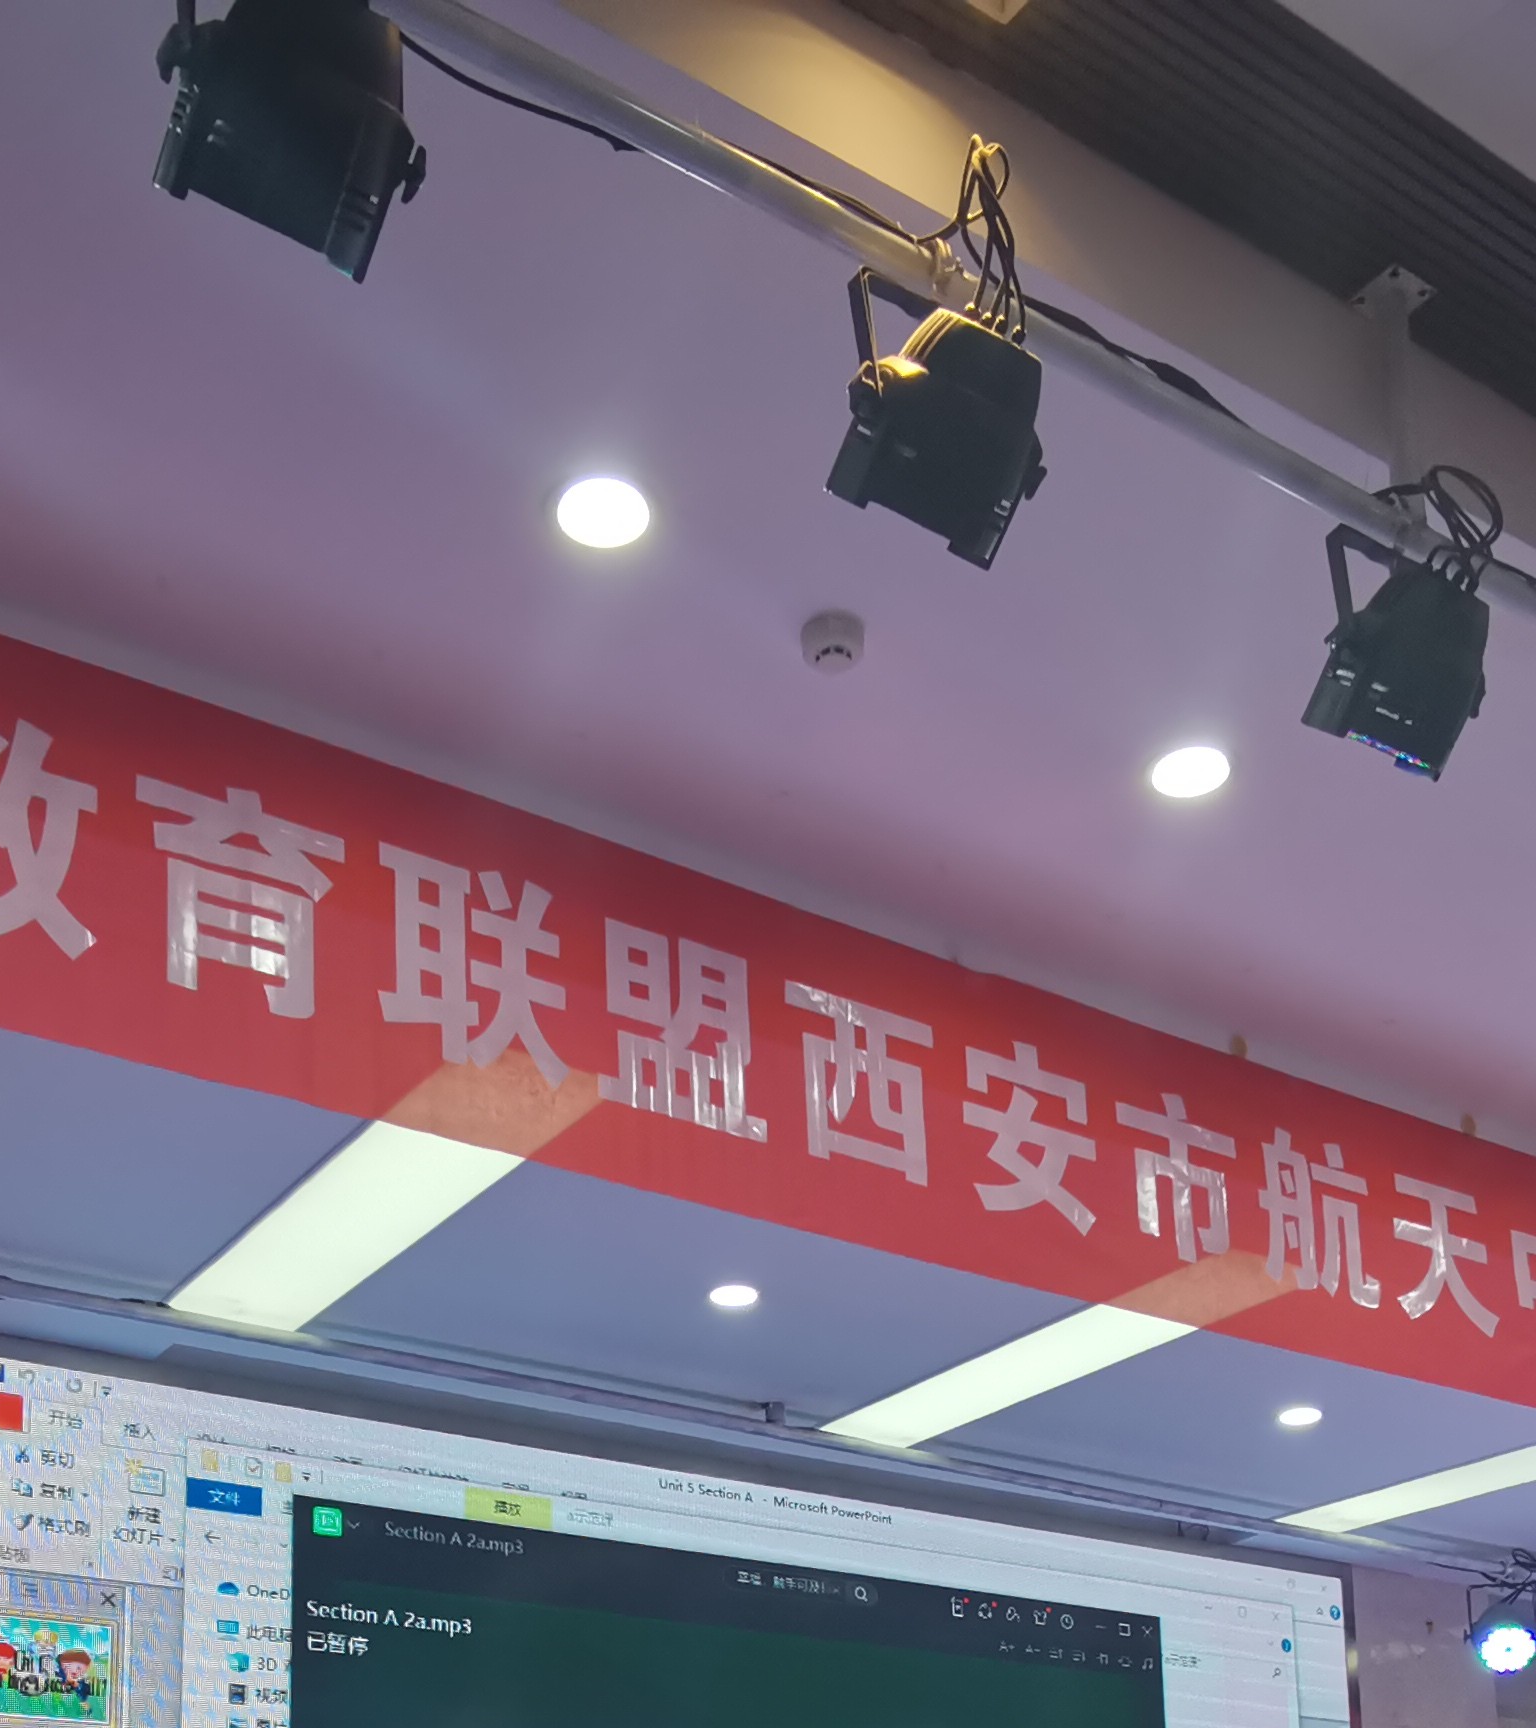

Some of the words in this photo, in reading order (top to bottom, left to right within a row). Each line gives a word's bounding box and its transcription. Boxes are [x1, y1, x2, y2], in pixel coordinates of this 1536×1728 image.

[48, 1409, 83, 1430] 开始
[124, 1422, 155, 1441] 插入
[41, 1449, 74, 1469] 剪切
[40, 1482, 74, 1501] 复制
[207, 1488, 240, 1506] 文件
[493, 1499, 521, 1518] 播放
[658, 1478, 683, 1493] Unit
[687, 1482, 696, 1493] 5
[698, 1484, 741, 1501] Section
[744, 1491, 754, 1503] A
[773, 1495, 828, 1515] Microsoft
[831, 1505, 892, 1525] PowerPoint
[127, 1505, 161, 1524] 新建
[39, 1515, 91, 1537] 格式刷
[114, 1527, 162, 1546] 幻灯片
[385, 1521, 446, 1546] Section
[450, 1531, 463, 1547] A
[466, 1533, 524, 1556] 2a.mp3
[306, 1600, 378, 1627] Section
[383, 1609, 398, 1627] A
[404, 1612, 473, 1639] 2a.mp3
[307, 1631, 369, 1657] 已暂停
[257, 1656, 278, 1672] 3D
[255, 1687, 288, 1704] 视频
